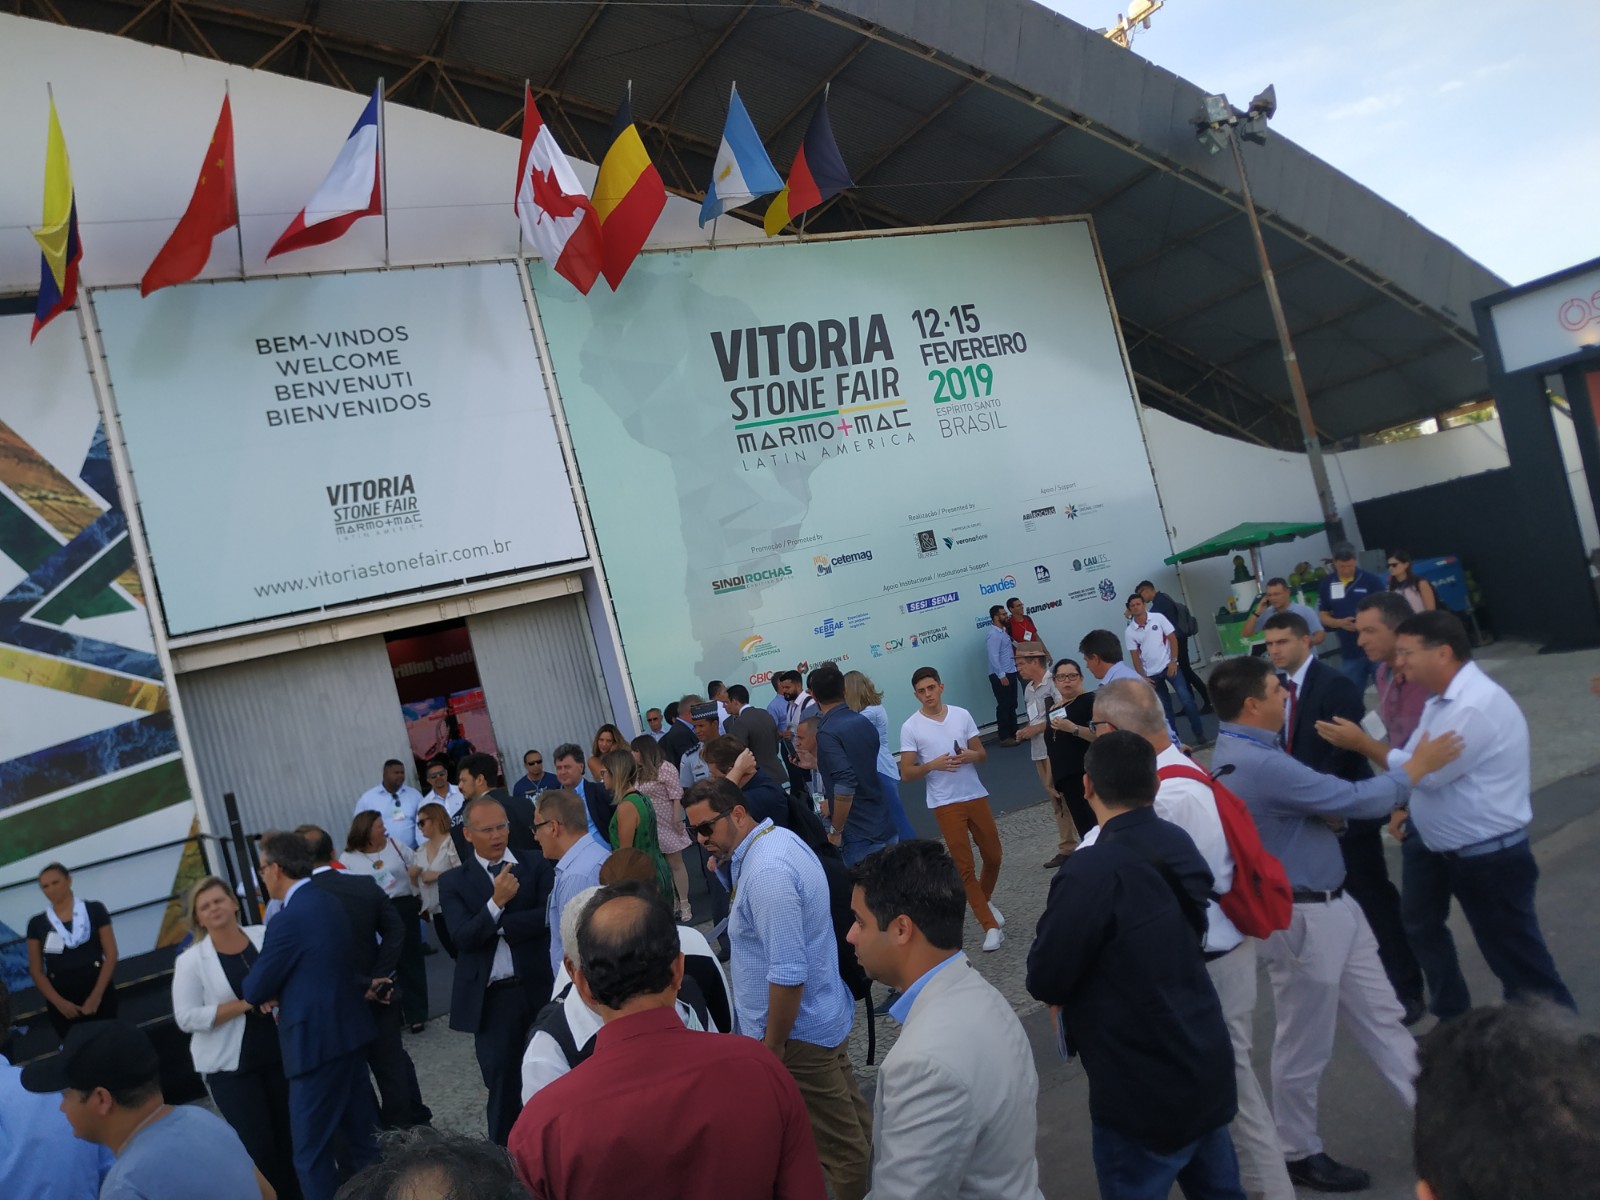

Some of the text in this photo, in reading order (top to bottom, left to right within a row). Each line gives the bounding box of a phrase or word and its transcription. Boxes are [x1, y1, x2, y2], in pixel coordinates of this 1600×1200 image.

[255, 325, 409, 355] BEM-VINDOS
[710, 313, 894, 382] VITORIA
[920, 331, 1028, 366] FEVEREIRO
[276, 349, 402, 377] WELCOME
[274, 371, 414, 401] BENVENUTI
[730, 366, 900, 421] STONE FAIR
[927, 363, 994, 404] 2019
[266, 392, 431, 427] BIENVENIDOS
[974, 398, 1002, 410] SANTO
[938, 410, 1008, 439] BRASIL
[742, 432, 916, 472] LATIN AMERICA
[326, 474, 415, 507] VITORIA
[334, 496, 418, 522] STONE FAIR
[941, 503, 968, 514] Presented
[787, 536, 816, 547] Promoted
[253, 538, 513, 598] www.vitoriastonefair.com.br
[831, 550, 873, 566] cetemag
[968, 561, 990, 571] Support
[712, 566, 793, 590] SINDIROCHAS
[979, 579, 1016, 595] bandes
[910, 600, 928, 611] SESI
[931, 593, 956, 606] SENAI
[814, 619, 844, 635] SEBRAE
[749, 670, 773, 685] CBIC
